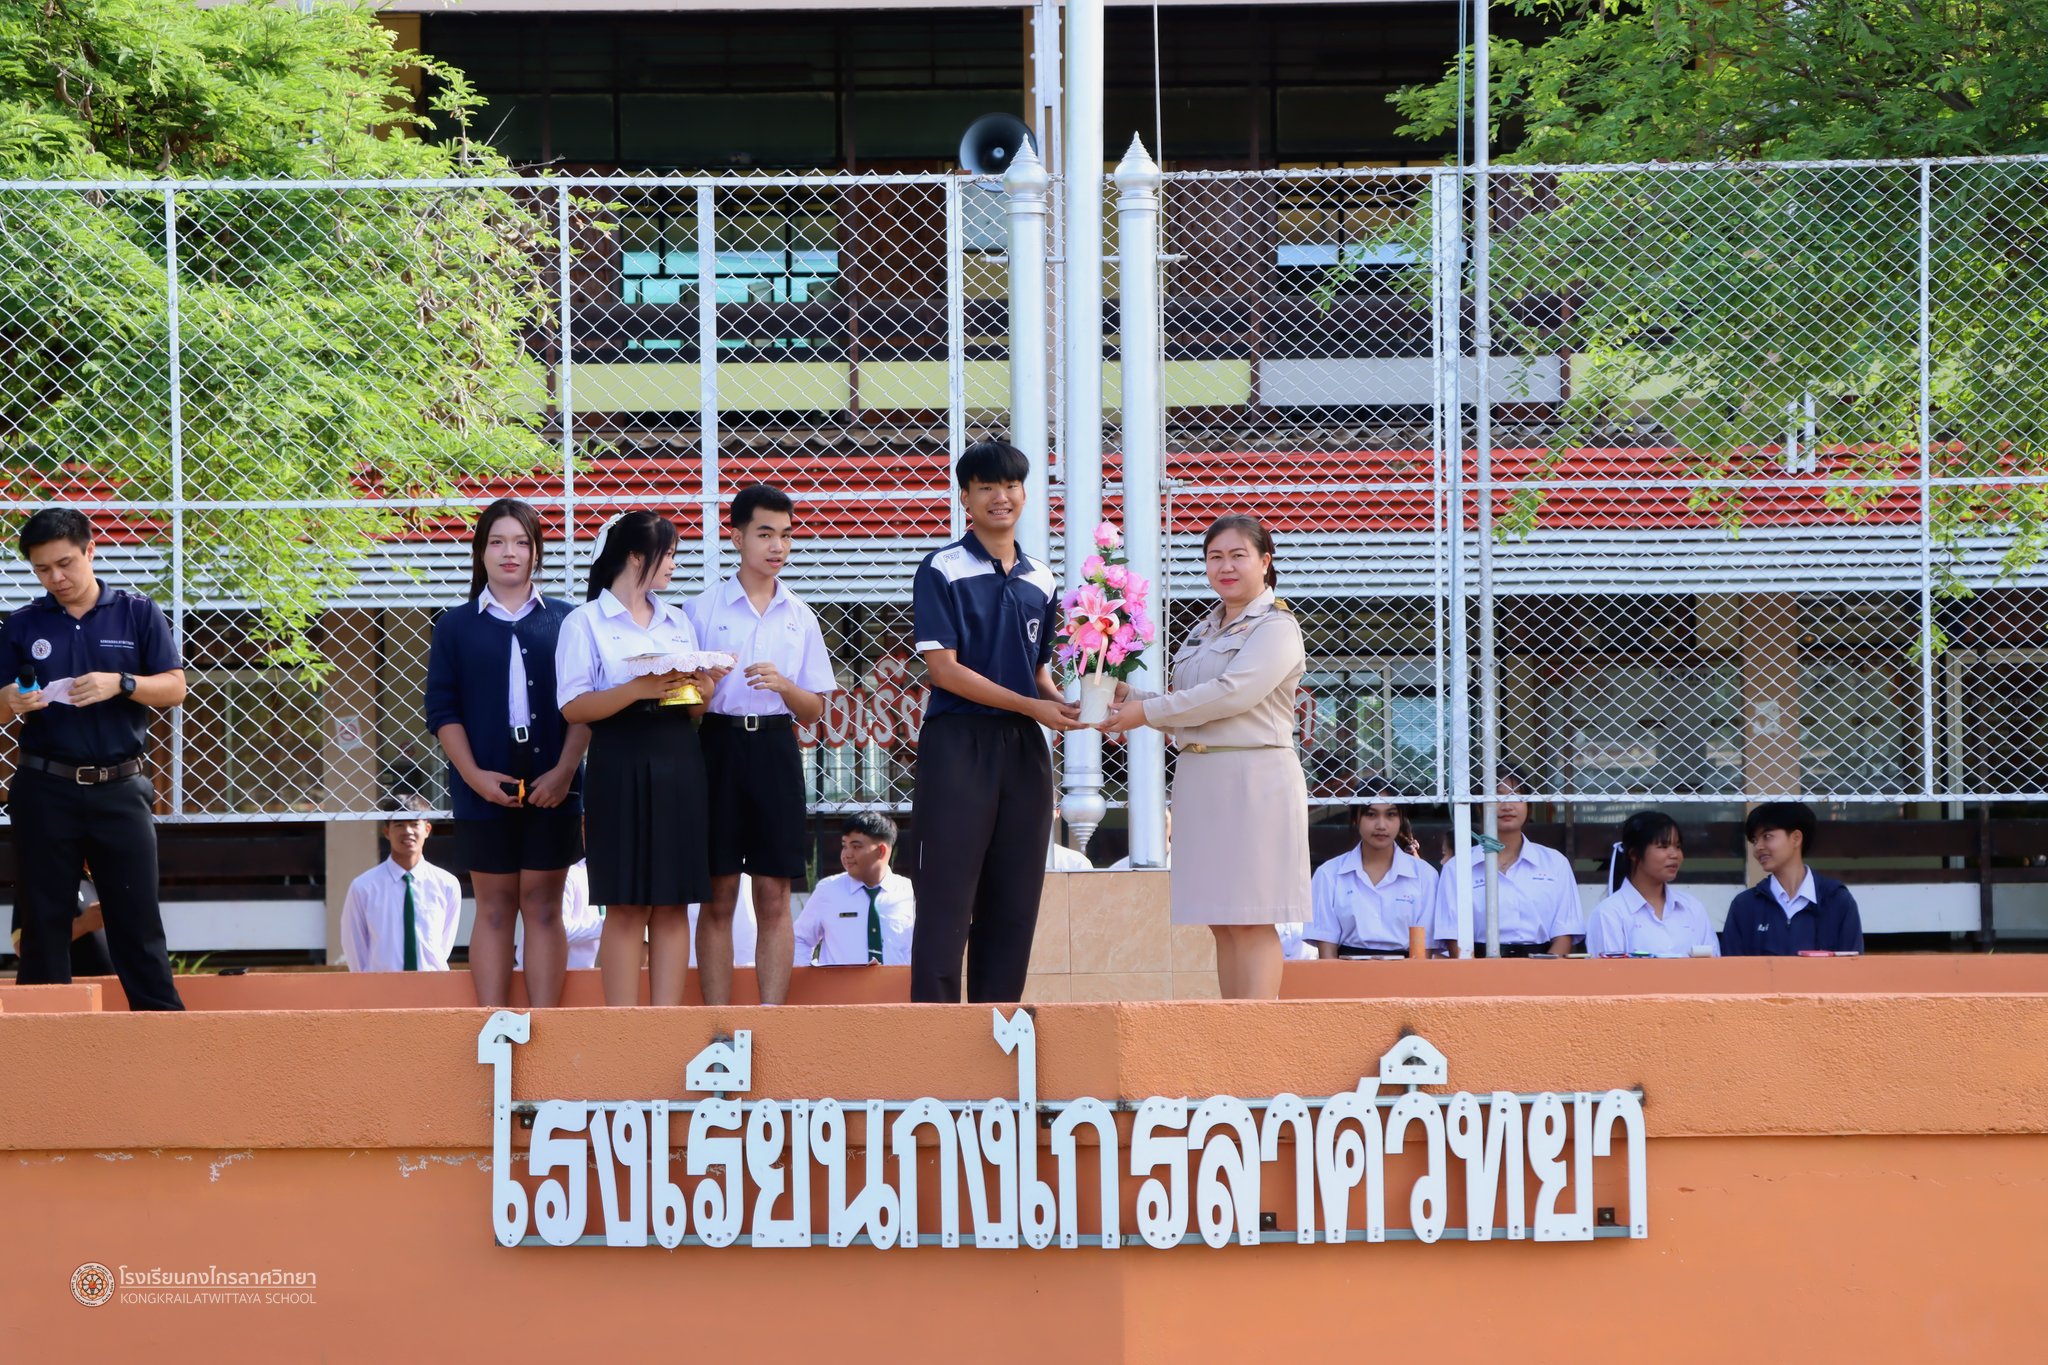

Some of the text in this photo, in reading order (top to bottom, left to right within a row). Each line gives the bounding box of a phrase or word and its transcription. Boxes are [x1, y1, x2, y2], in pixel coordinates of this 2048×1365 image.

[478, 1008, 1648, 1250] โรงเรียนกงไกรลาศวิทยา
